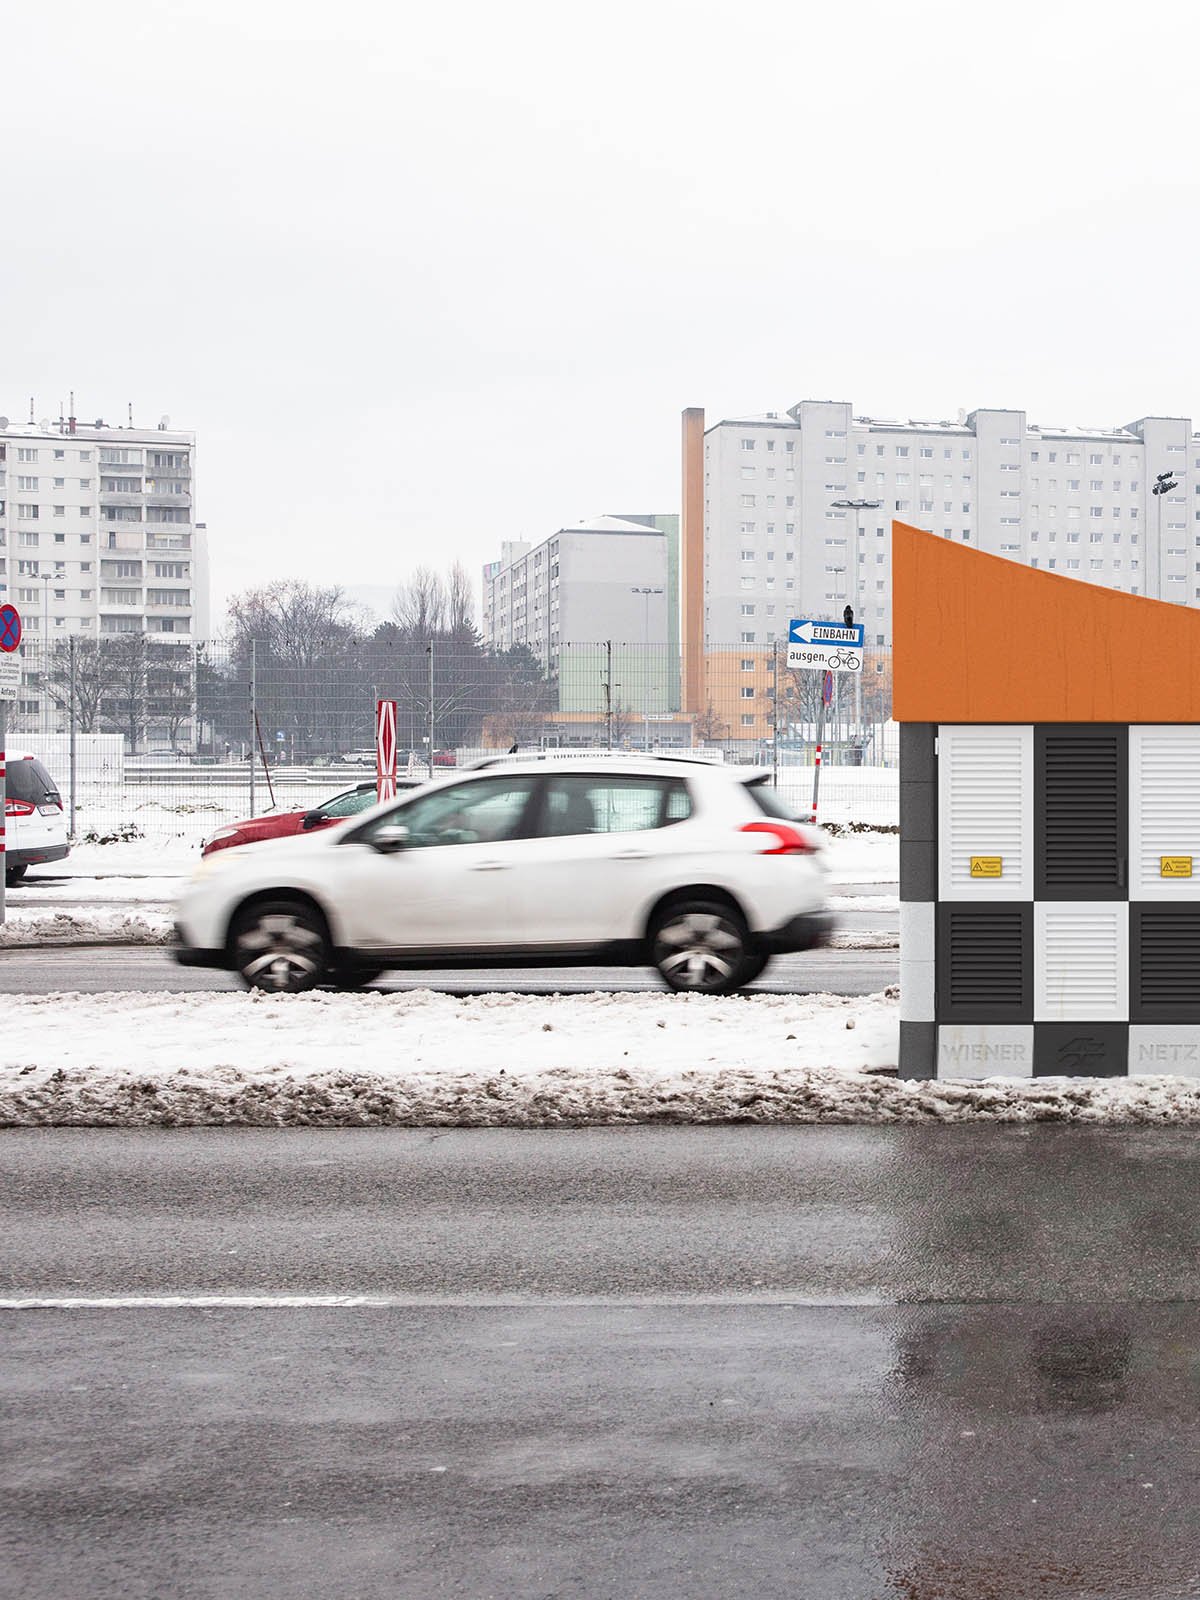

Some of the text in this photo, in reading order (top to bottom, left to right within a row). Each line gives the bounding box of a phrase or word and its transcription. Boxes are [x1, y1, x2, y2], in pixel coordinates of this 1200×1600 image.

[813, 628, 855, 640] EINBAHN
[790, 652, 827, 663] ausgen.
[943, 1044, 1025, 1061] WIENER
